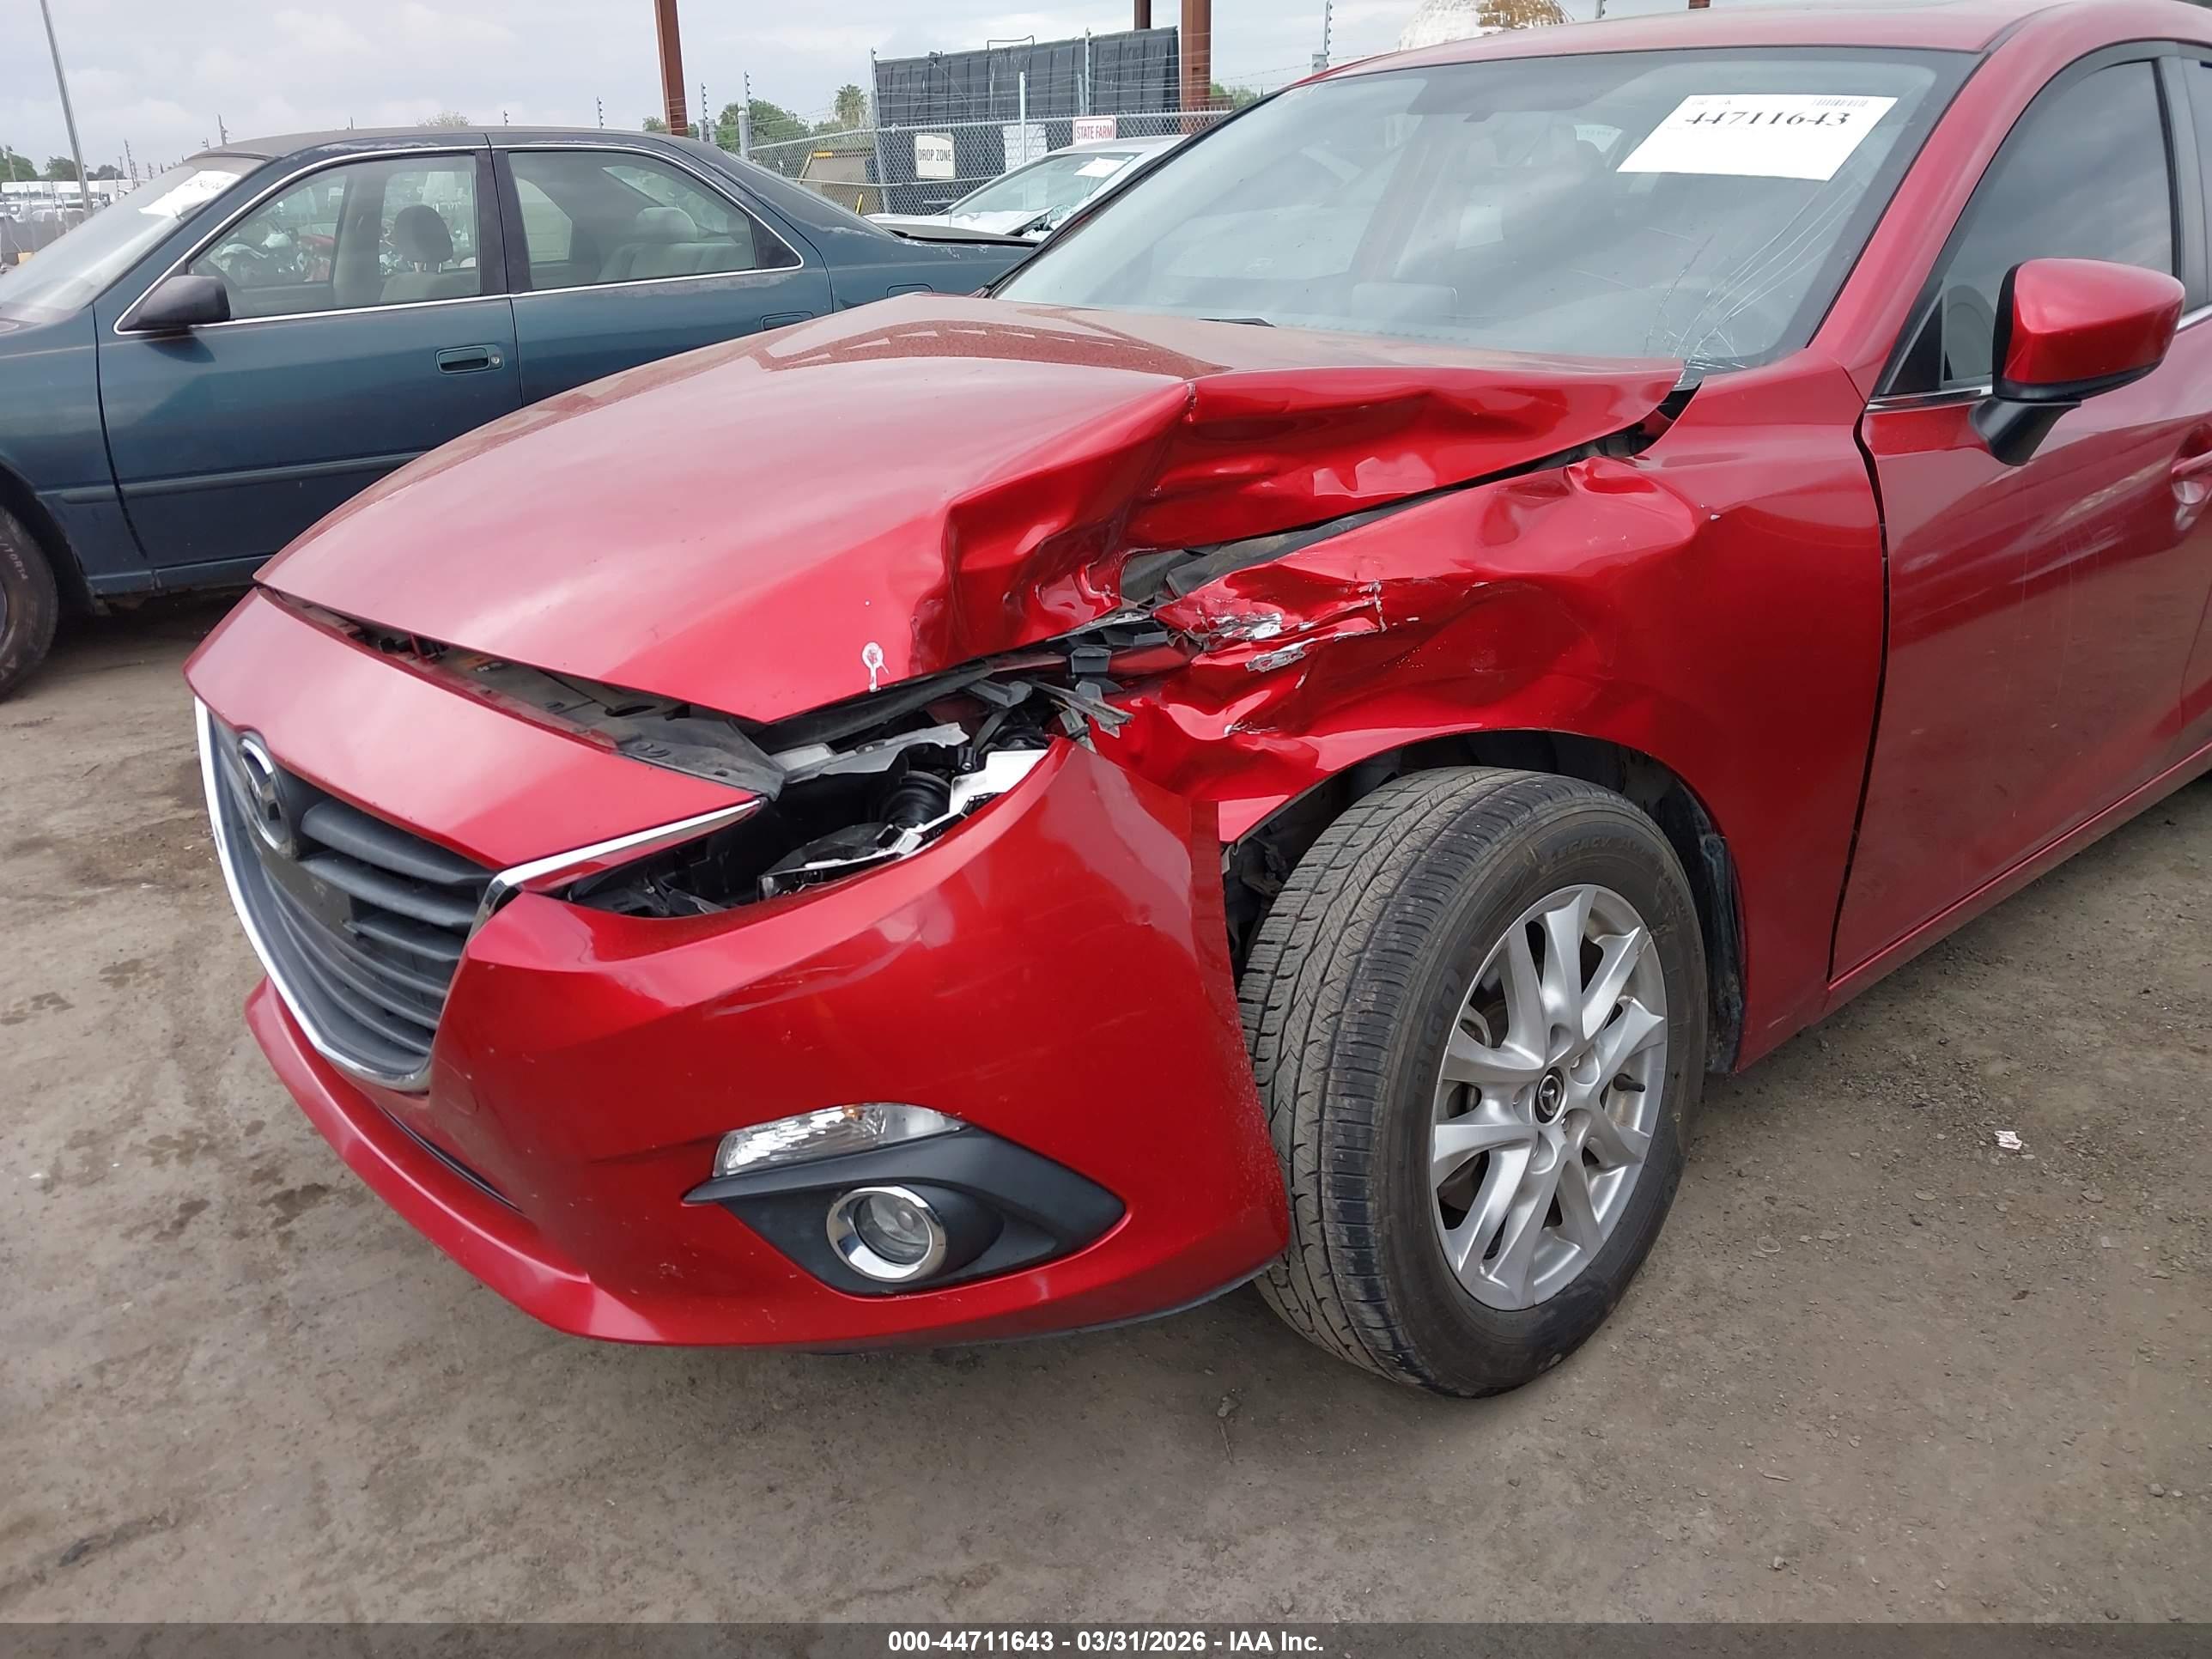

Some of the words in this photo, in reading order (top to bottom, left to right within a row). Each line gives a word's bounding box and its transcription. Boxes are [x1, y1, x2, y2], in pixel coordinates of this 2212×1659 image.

[1685, 111, 1850, 126] 44711643
[1076, 125, 1094, 139] STATE
[1096, 124, 1113, 138] FARM
[918, 149, 934, 161] DROP
[936, 149, 951, 161] ZONE
